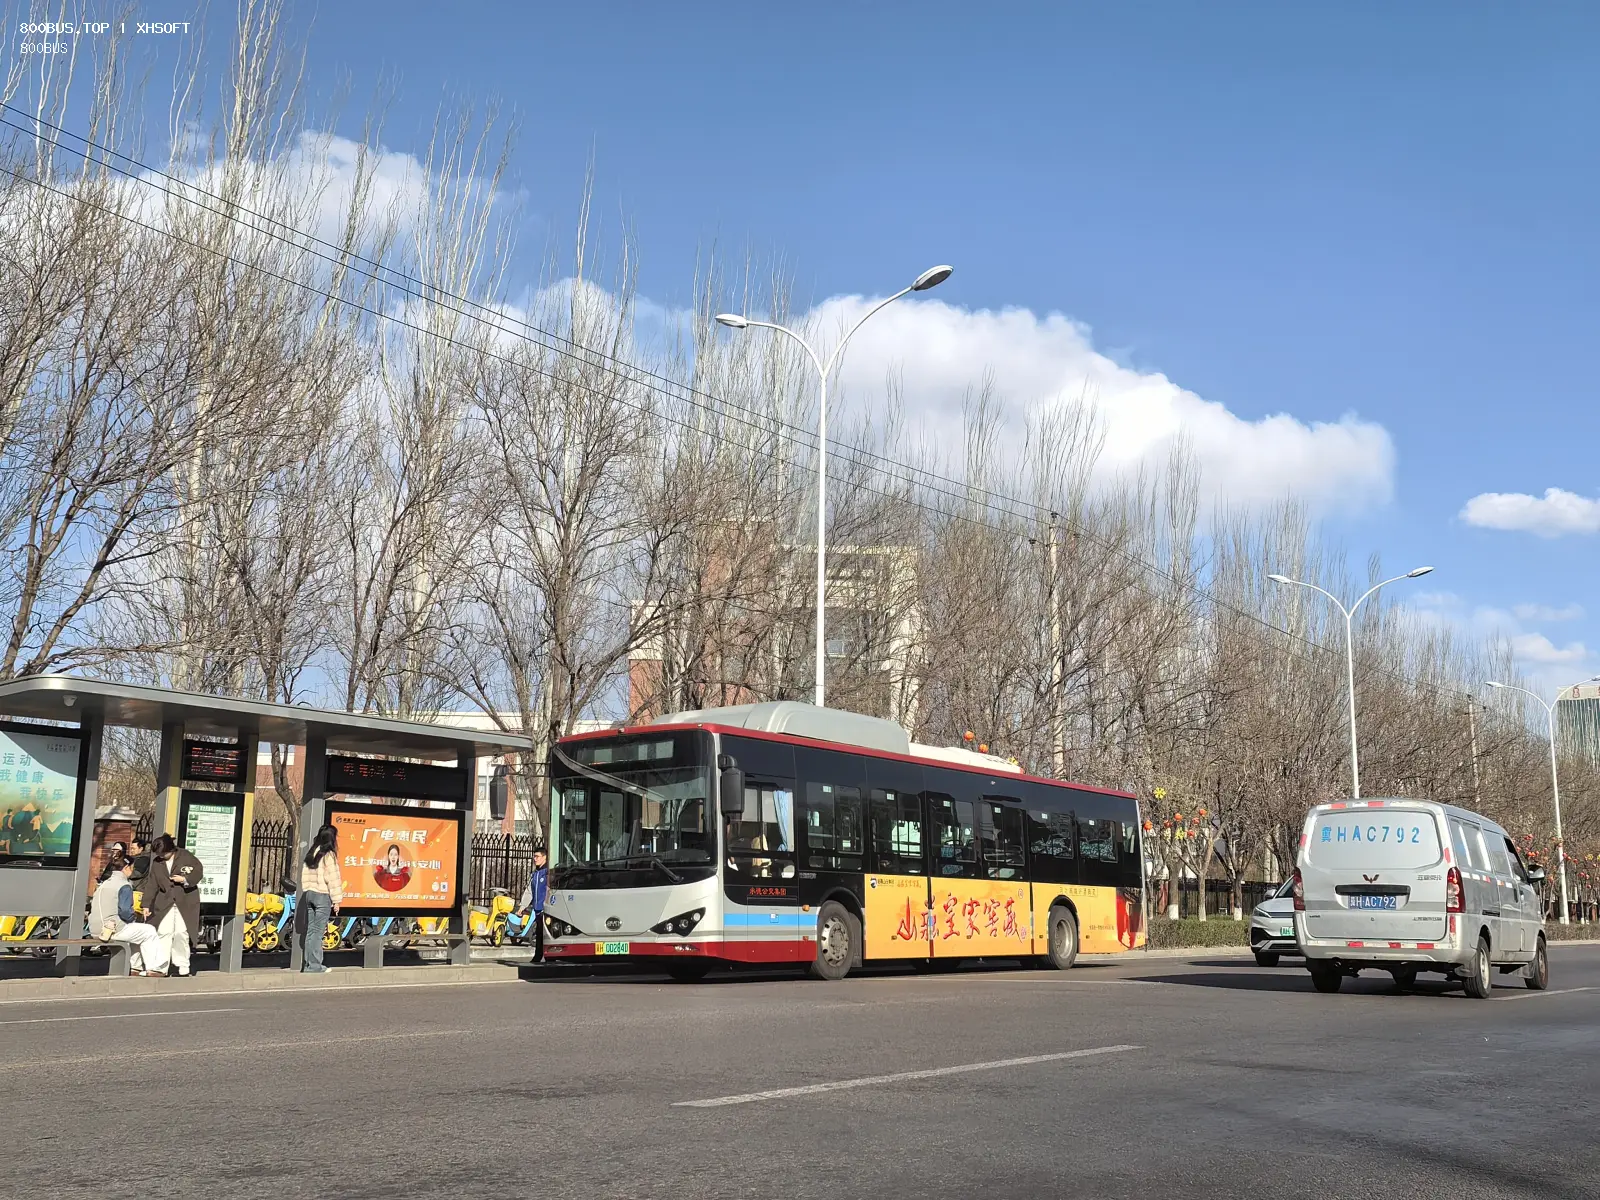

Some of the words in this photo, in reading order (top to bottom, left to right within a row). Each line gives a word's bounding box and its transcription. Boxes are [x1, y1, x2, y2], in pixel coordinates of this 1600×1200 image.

[3, 752, 32, 767] 运动
[0, 769, 44, 784] 我健康
[20, 787, 64, 801] 我快乐
[361, 827, 428, 845] 广电惠民
[1321, 825, 1420, 843] 冀HAC792
